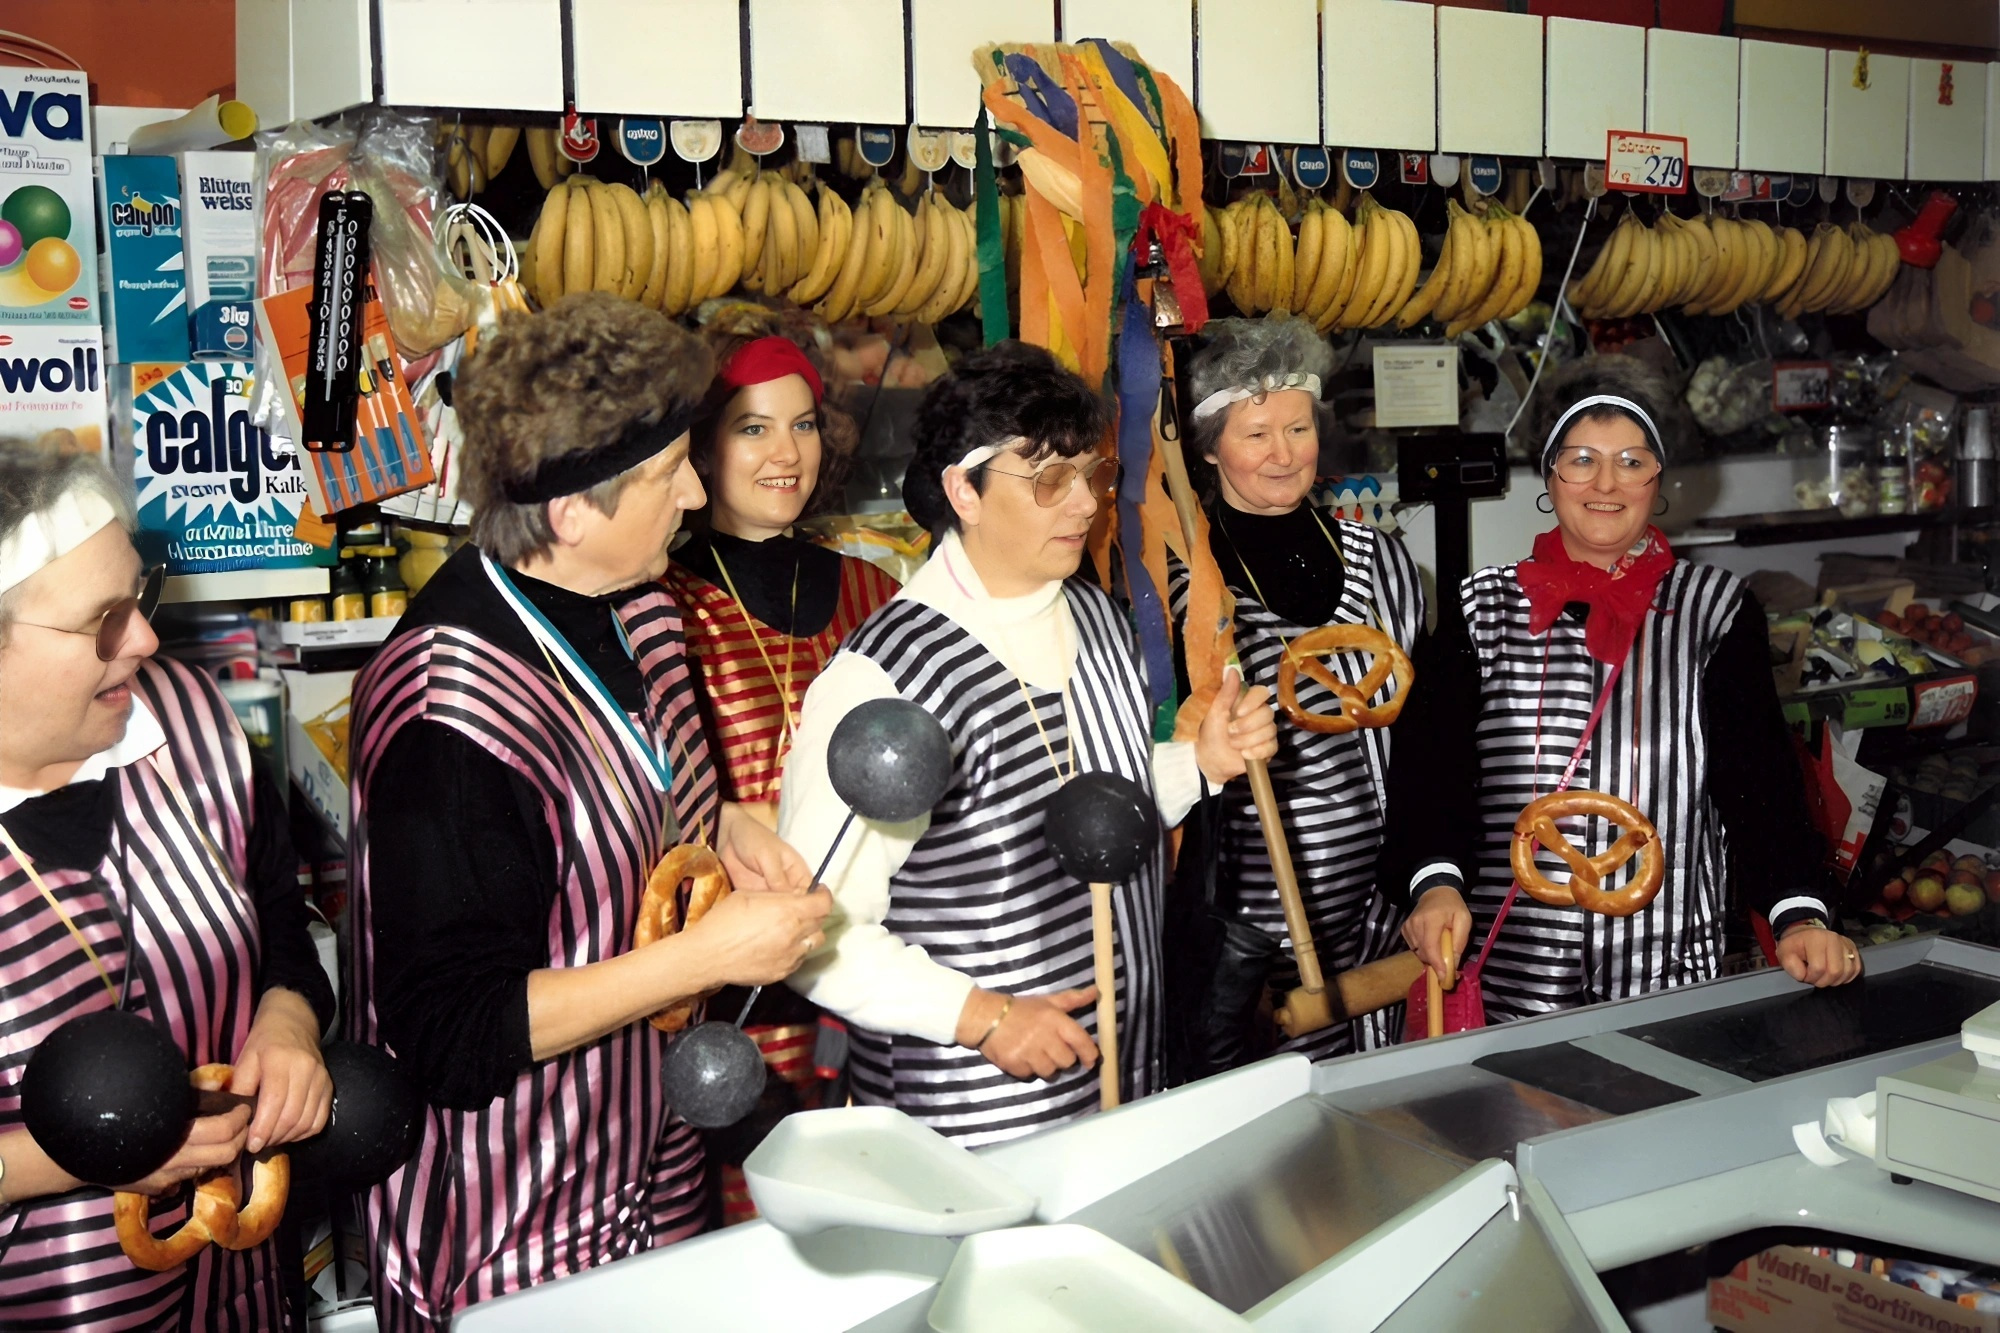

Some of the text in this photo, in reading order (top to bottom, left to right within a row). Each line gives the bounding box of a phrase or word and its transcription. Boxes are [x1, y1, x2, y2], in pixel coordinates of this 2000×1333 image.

[0, 346, 99, 394] woll
[146, 378, 302, 504] calgo
[265, 476, 308, 494] Kalk
